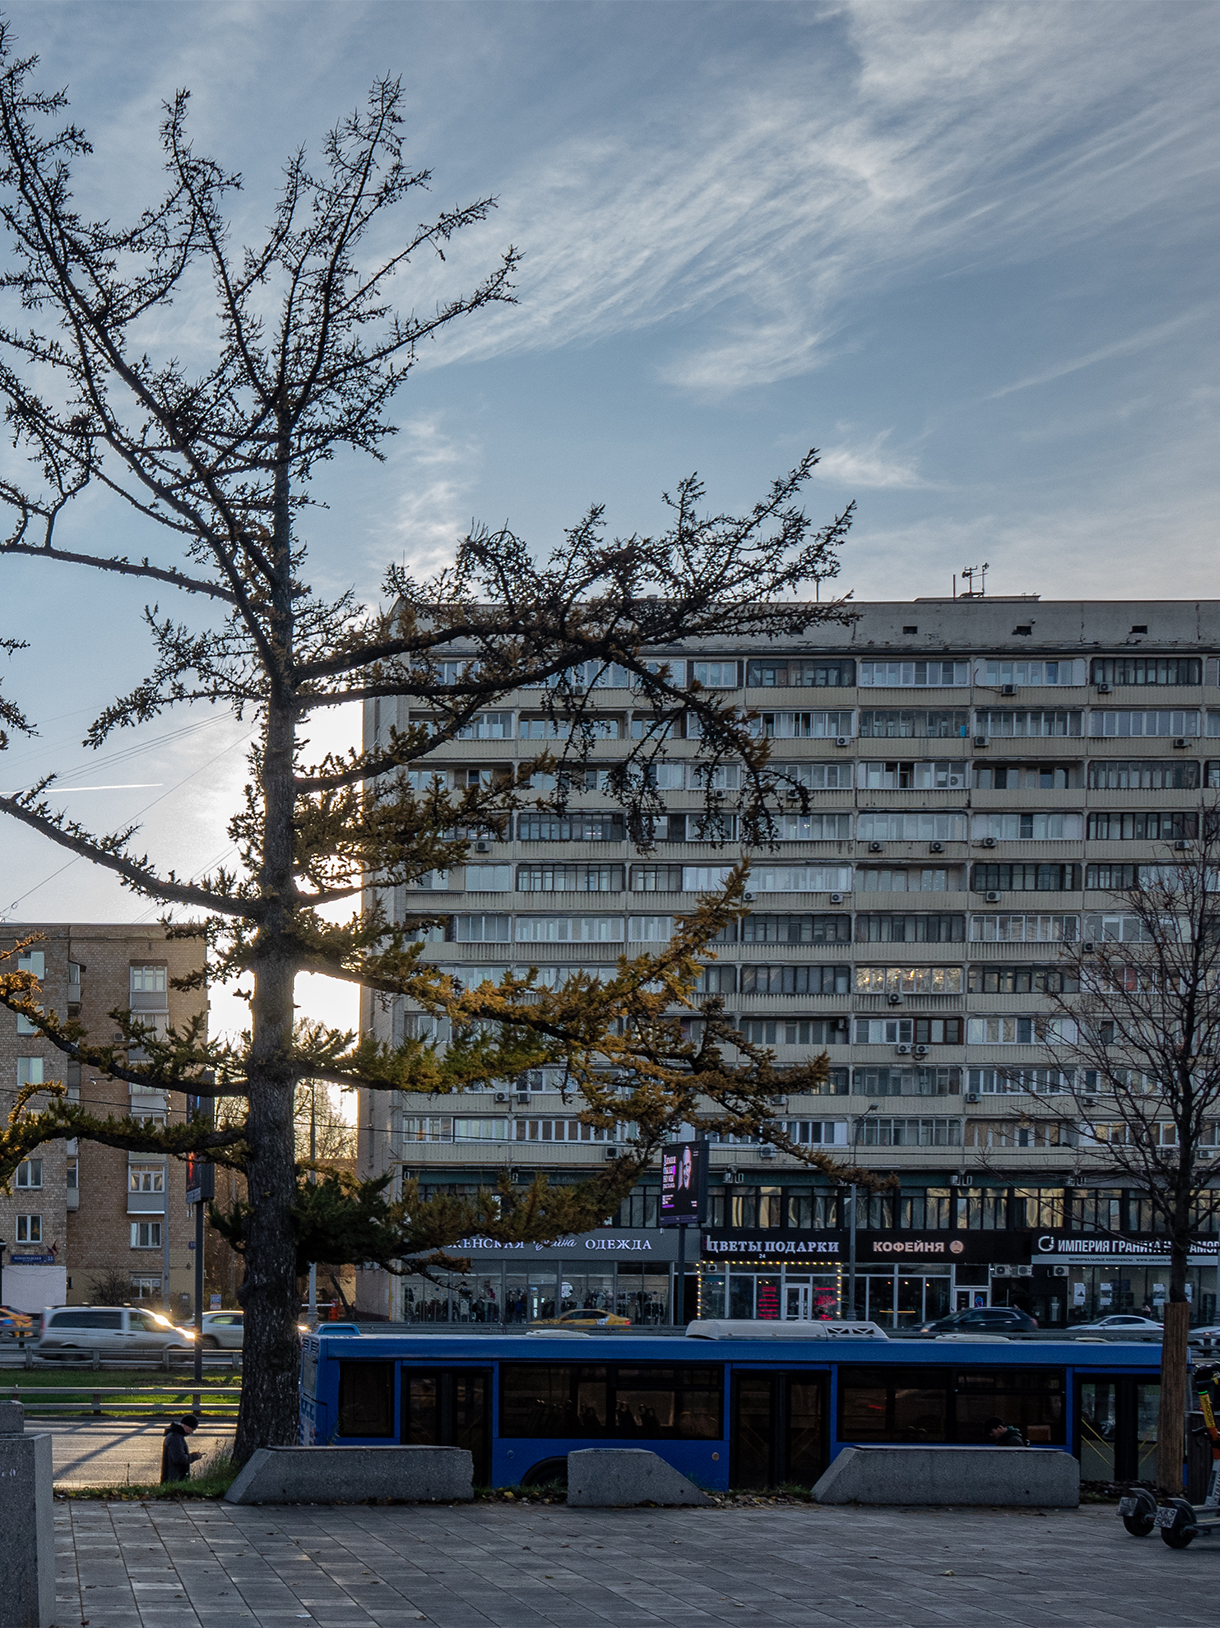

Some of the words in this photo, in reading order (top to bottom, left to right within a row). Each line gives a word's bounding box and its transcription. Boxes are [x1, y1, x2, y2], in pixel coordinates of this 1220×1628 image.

[585, 1239, 652, 1251] ОДЕЖДА
[708, 1240, 761, 1253] ЦВЕТЫ
[765, 1241, 839, 1254] ПОДАРКИ
[873, 1240, 945, 1252] КОФЕЙНЯ
[1058, 1240, 1110, 1252] ИМПЕРИЯ
